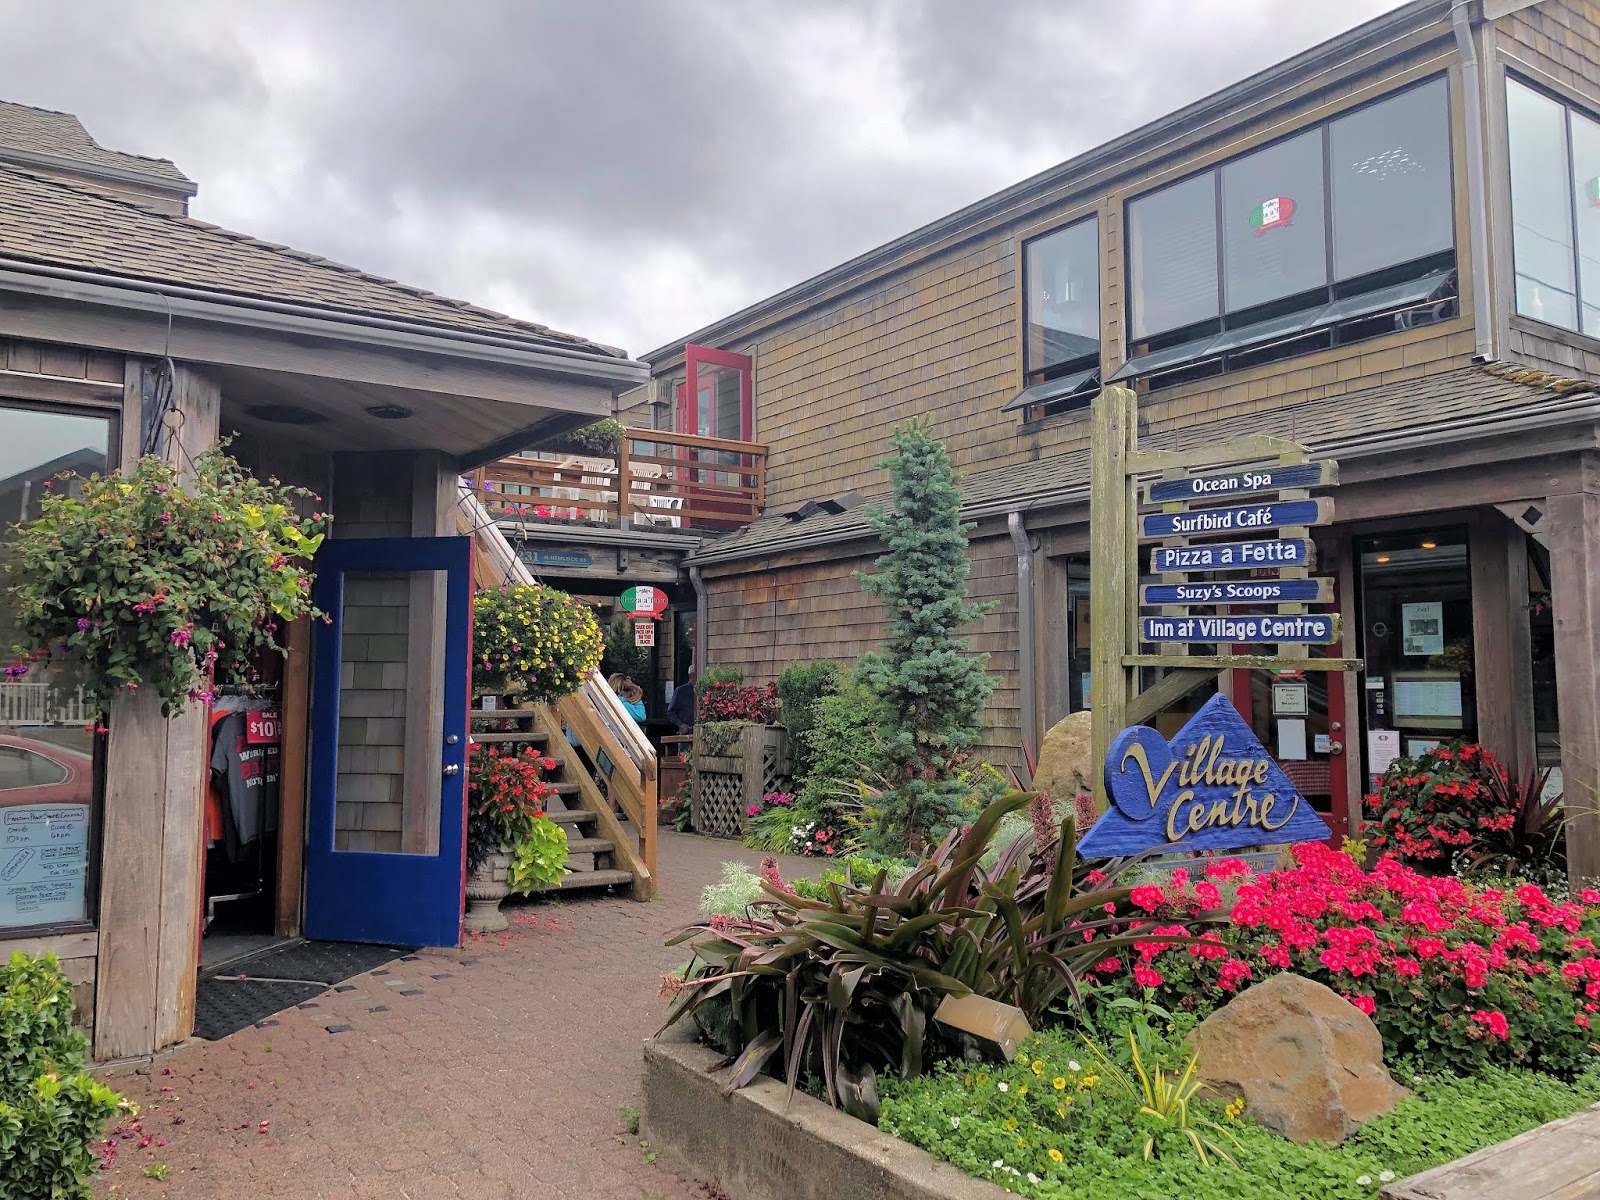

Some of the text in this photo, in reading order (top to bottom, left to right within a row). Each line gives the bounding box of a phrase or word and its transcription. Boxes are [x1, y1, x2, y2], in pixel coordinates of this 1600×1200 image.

[1192, 473, 1272, 493] Ocean Spa
[1172, 507, 1272, 532] Surfbird Café
[1165, 543, 1297, 567] Pizza a Fetta
[1176, 584, 1281, 602] Suzy's Scoops
[1150, 618, 1325, 640] Inn at Village Centre
[261, 711, 278, 719] SALE
[250, 721, 274, 737] $10
[1121, 734, 1269, 808] Village
[1166, 788, 1299, 842] Centre
